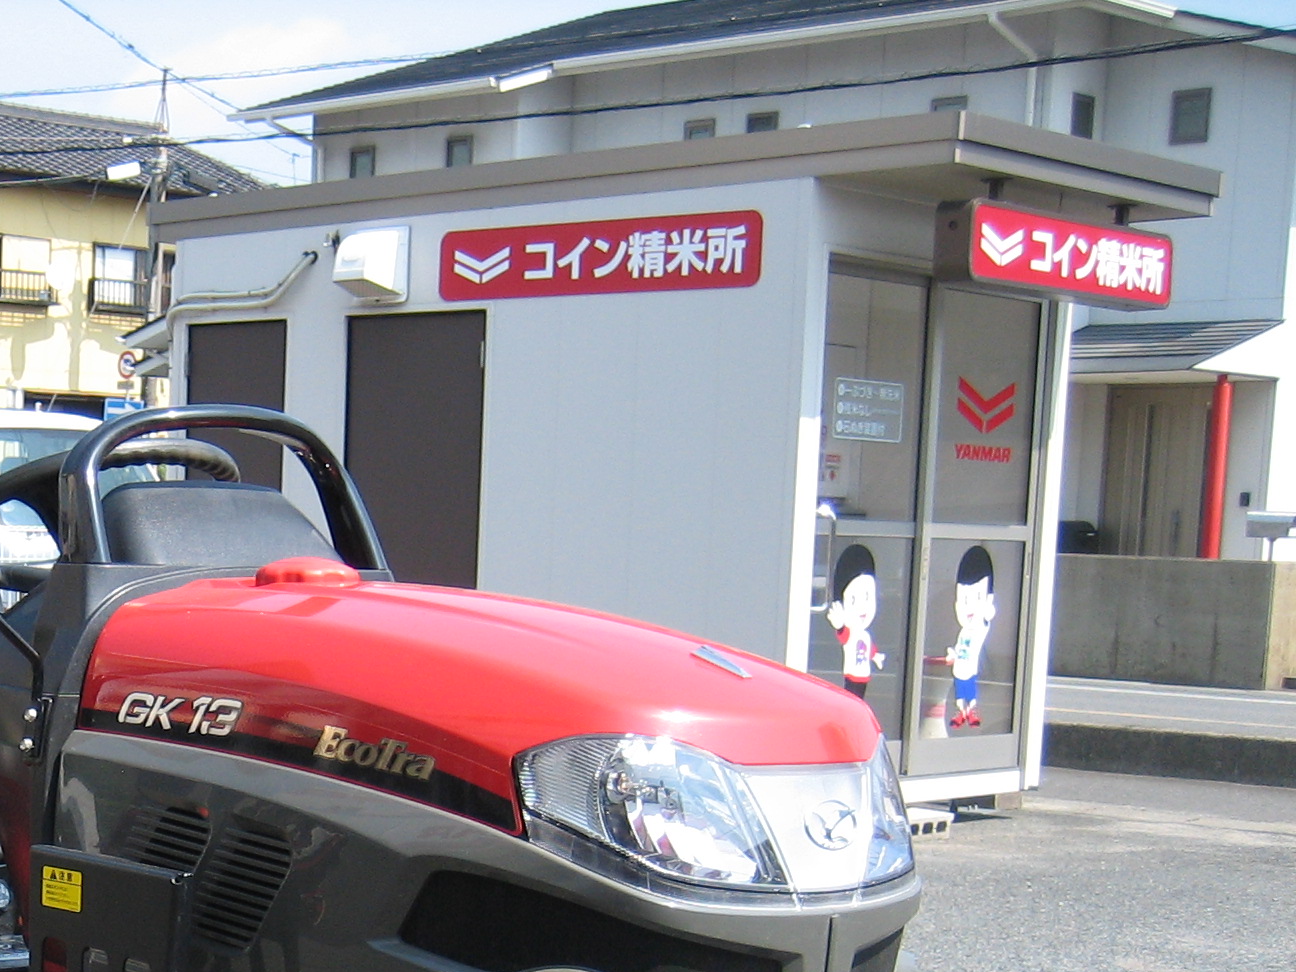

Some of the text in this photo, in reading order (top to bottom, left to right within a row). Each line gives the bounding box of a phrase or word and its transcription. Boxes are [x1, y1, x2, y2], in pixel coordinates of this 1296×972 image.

[523, 225, 747, 280] コイン精米所
[1029, 230, 1165, 295] コイン精米所
[954, 443, 1012, 463] YANMAR
[117, 692, 243, 736] GK 13
[313, 725, 436, 780] EcoTra
